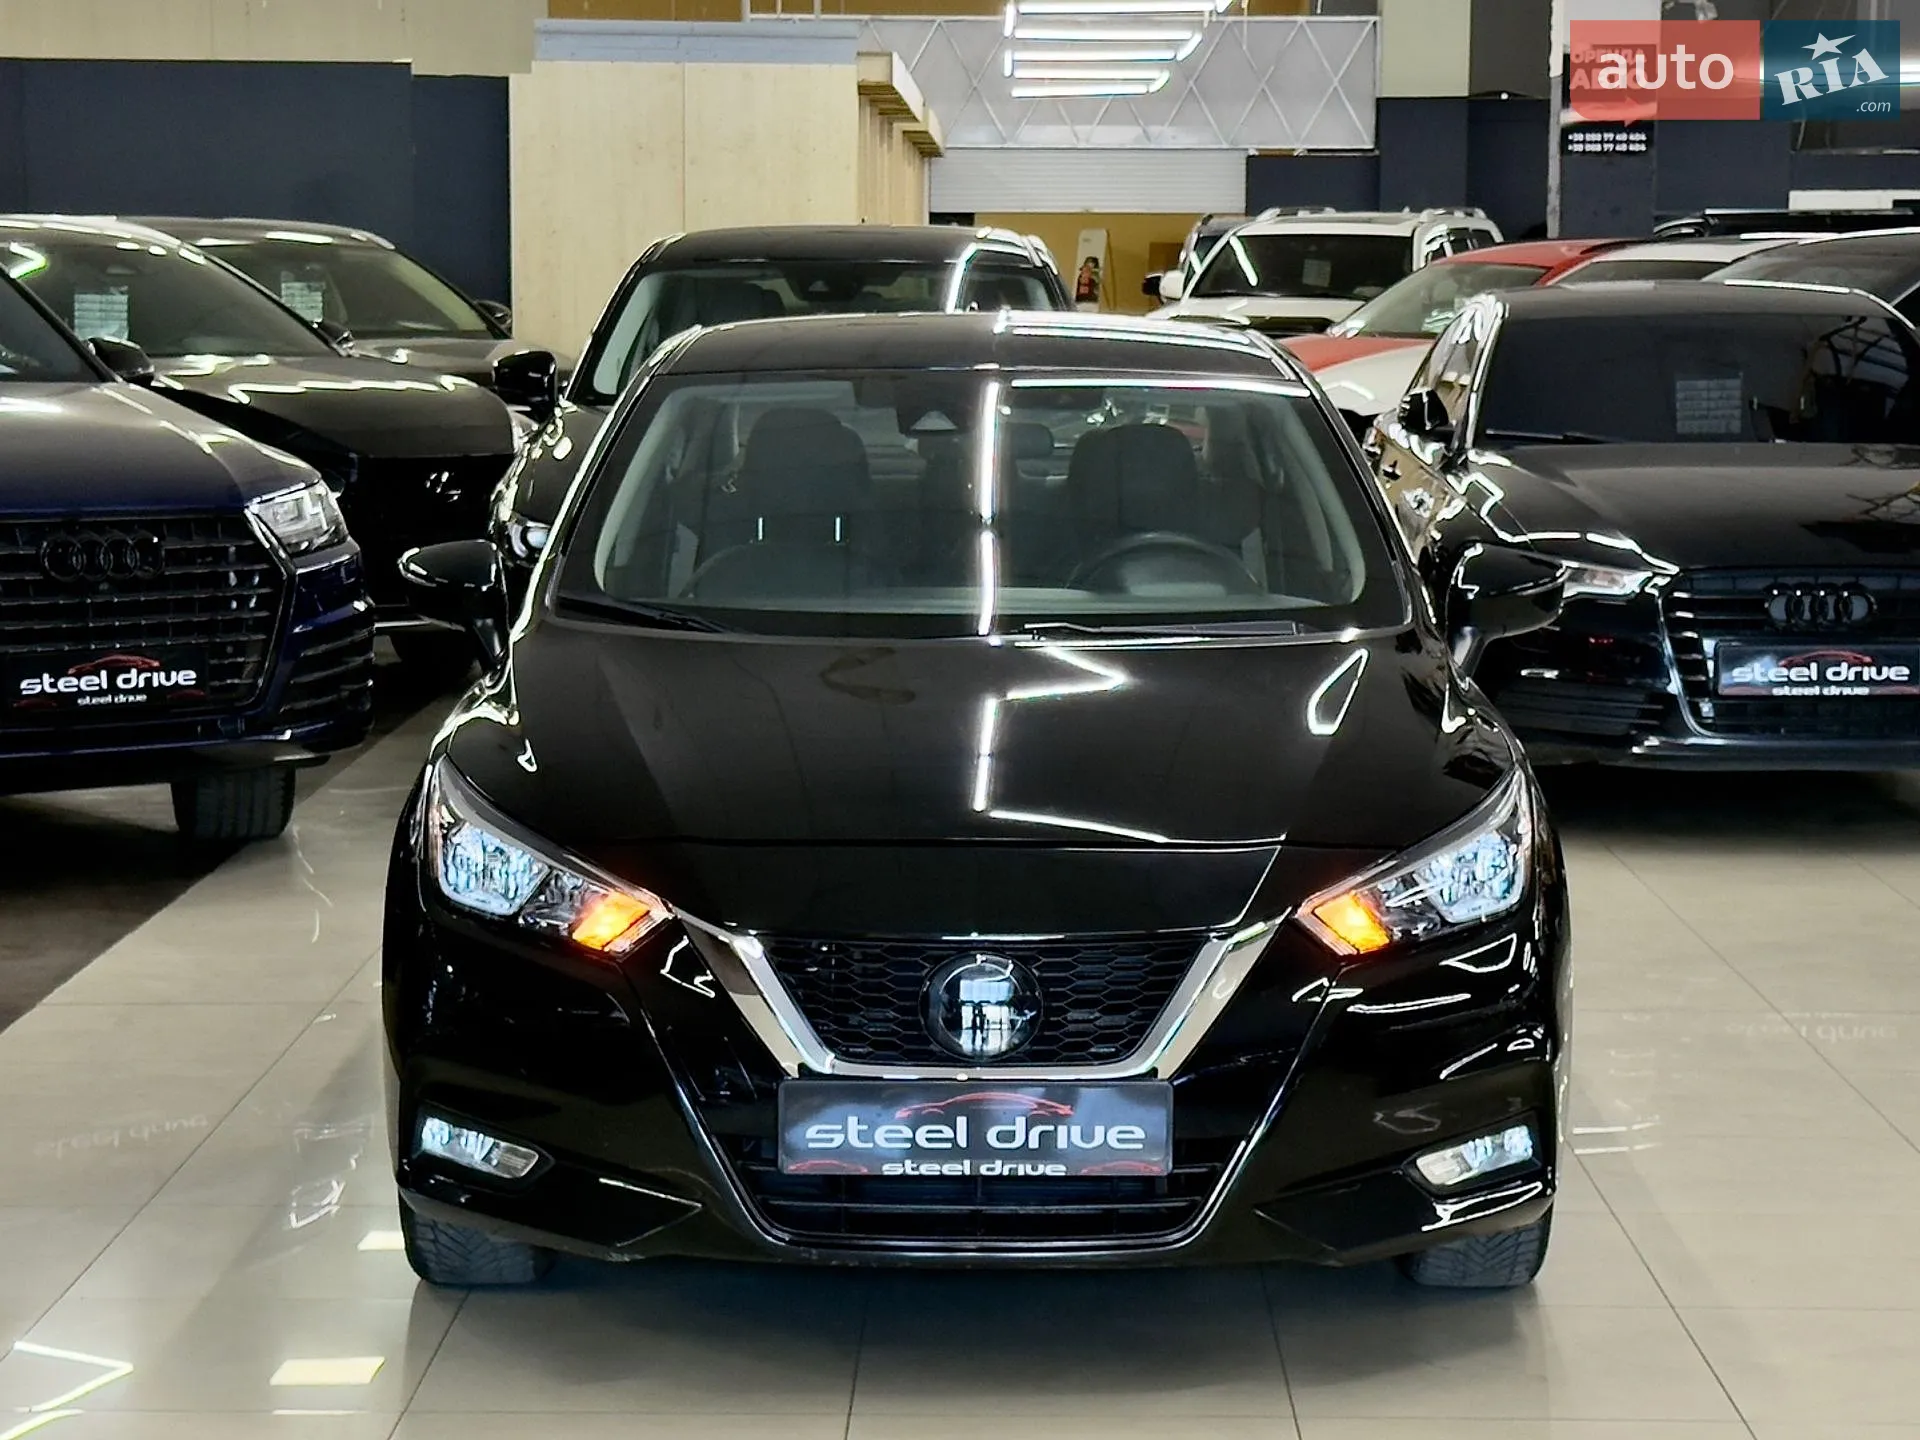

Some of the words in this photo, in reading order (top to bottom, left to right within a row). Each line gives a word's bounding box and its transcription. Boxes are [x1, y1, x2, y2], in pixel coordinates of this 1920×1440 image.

[1732, 662, 1818, 682] steel
[1825, 662, 1911, 682] drive
[20, 670, 108, 695] steel
[115, 668, 197, 690] drive
[1771, 685, 1820, 696] steel
[1822, 685, 1870, 696] drive
[77, 694, 112, 706] steel
[114, 693, 147, 704] drive
[805, 1116, 969, 1149] steel
[986, 1116, 1146, 1149] drive
[882, 1160, 971, 1176] steel
[980, 1160, 1067, 1176] drive
